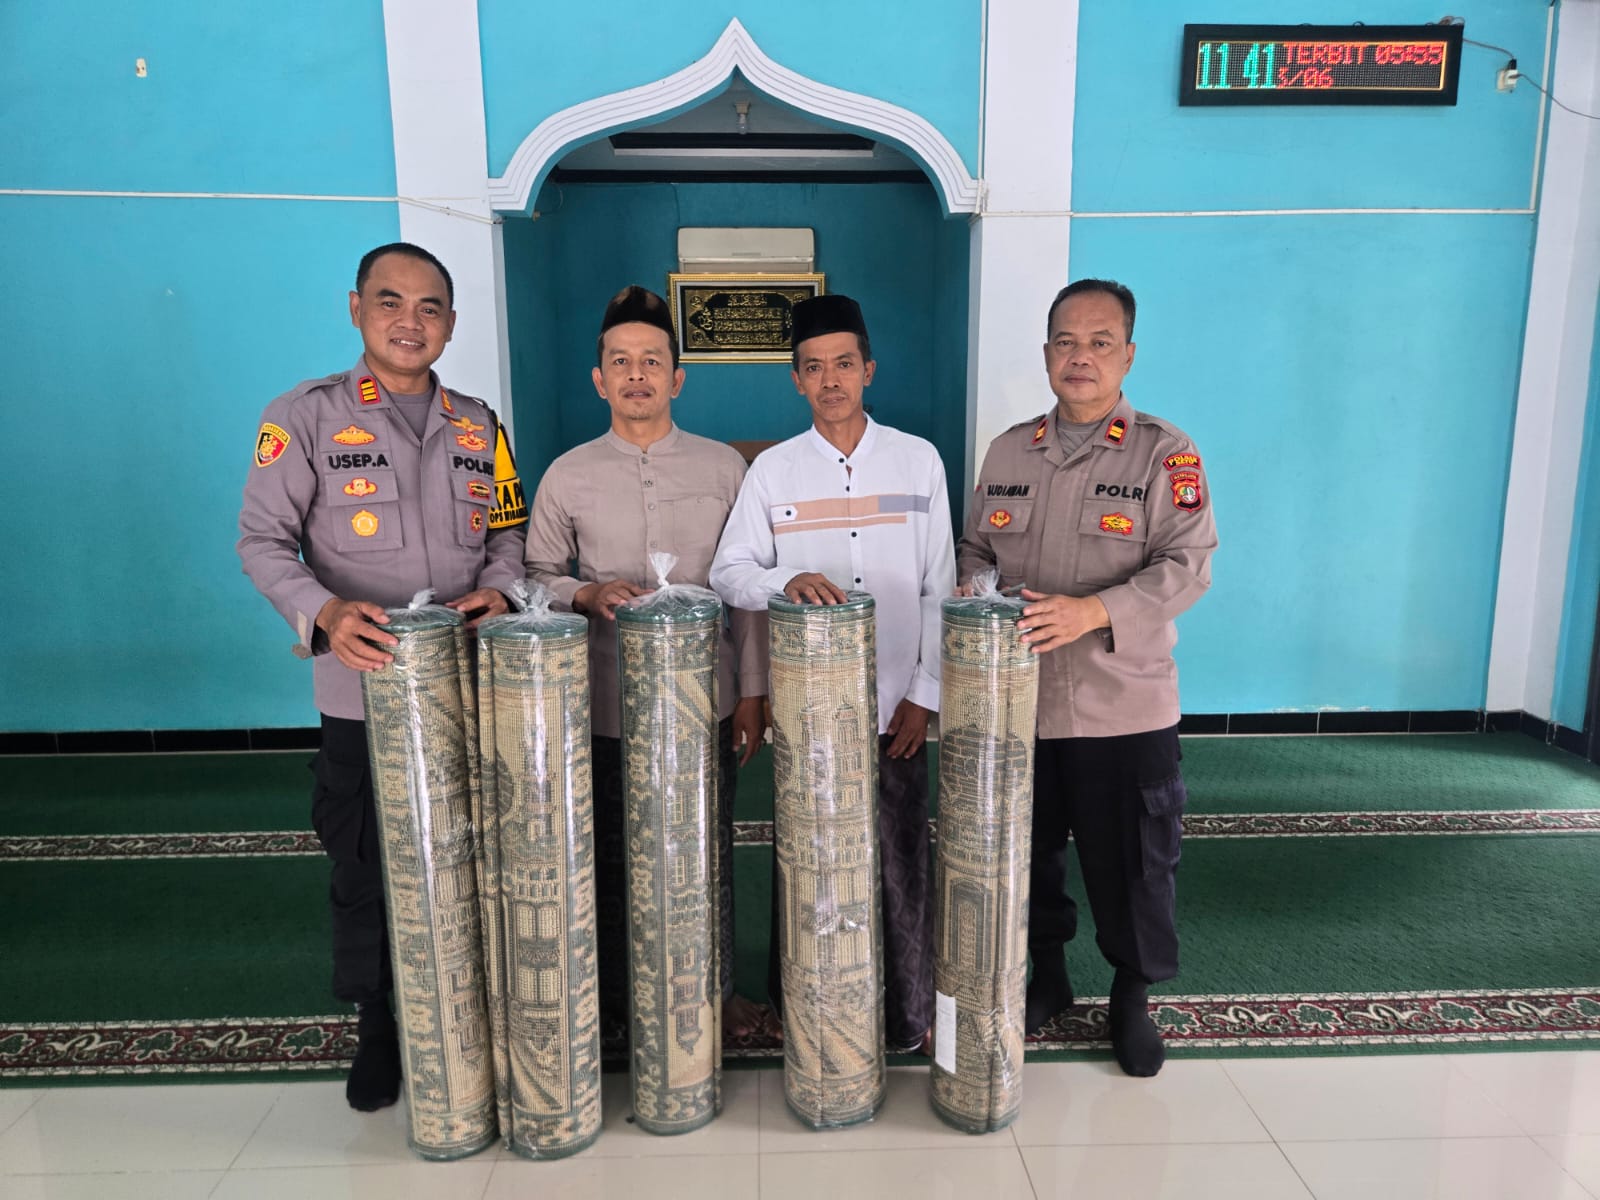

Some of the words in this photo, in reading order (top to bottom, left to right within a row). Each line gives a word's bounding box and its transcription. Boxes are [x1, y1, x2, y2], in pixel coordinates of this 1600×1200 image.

[1283, 42, 1368, 65] TERBIT
[1196, 43, 1231, 90] 11
[1243, 43, 1277, 90] 41
[328, 453, 388, 470] USEP.A
[453, 455, 494, 476] POLRI
